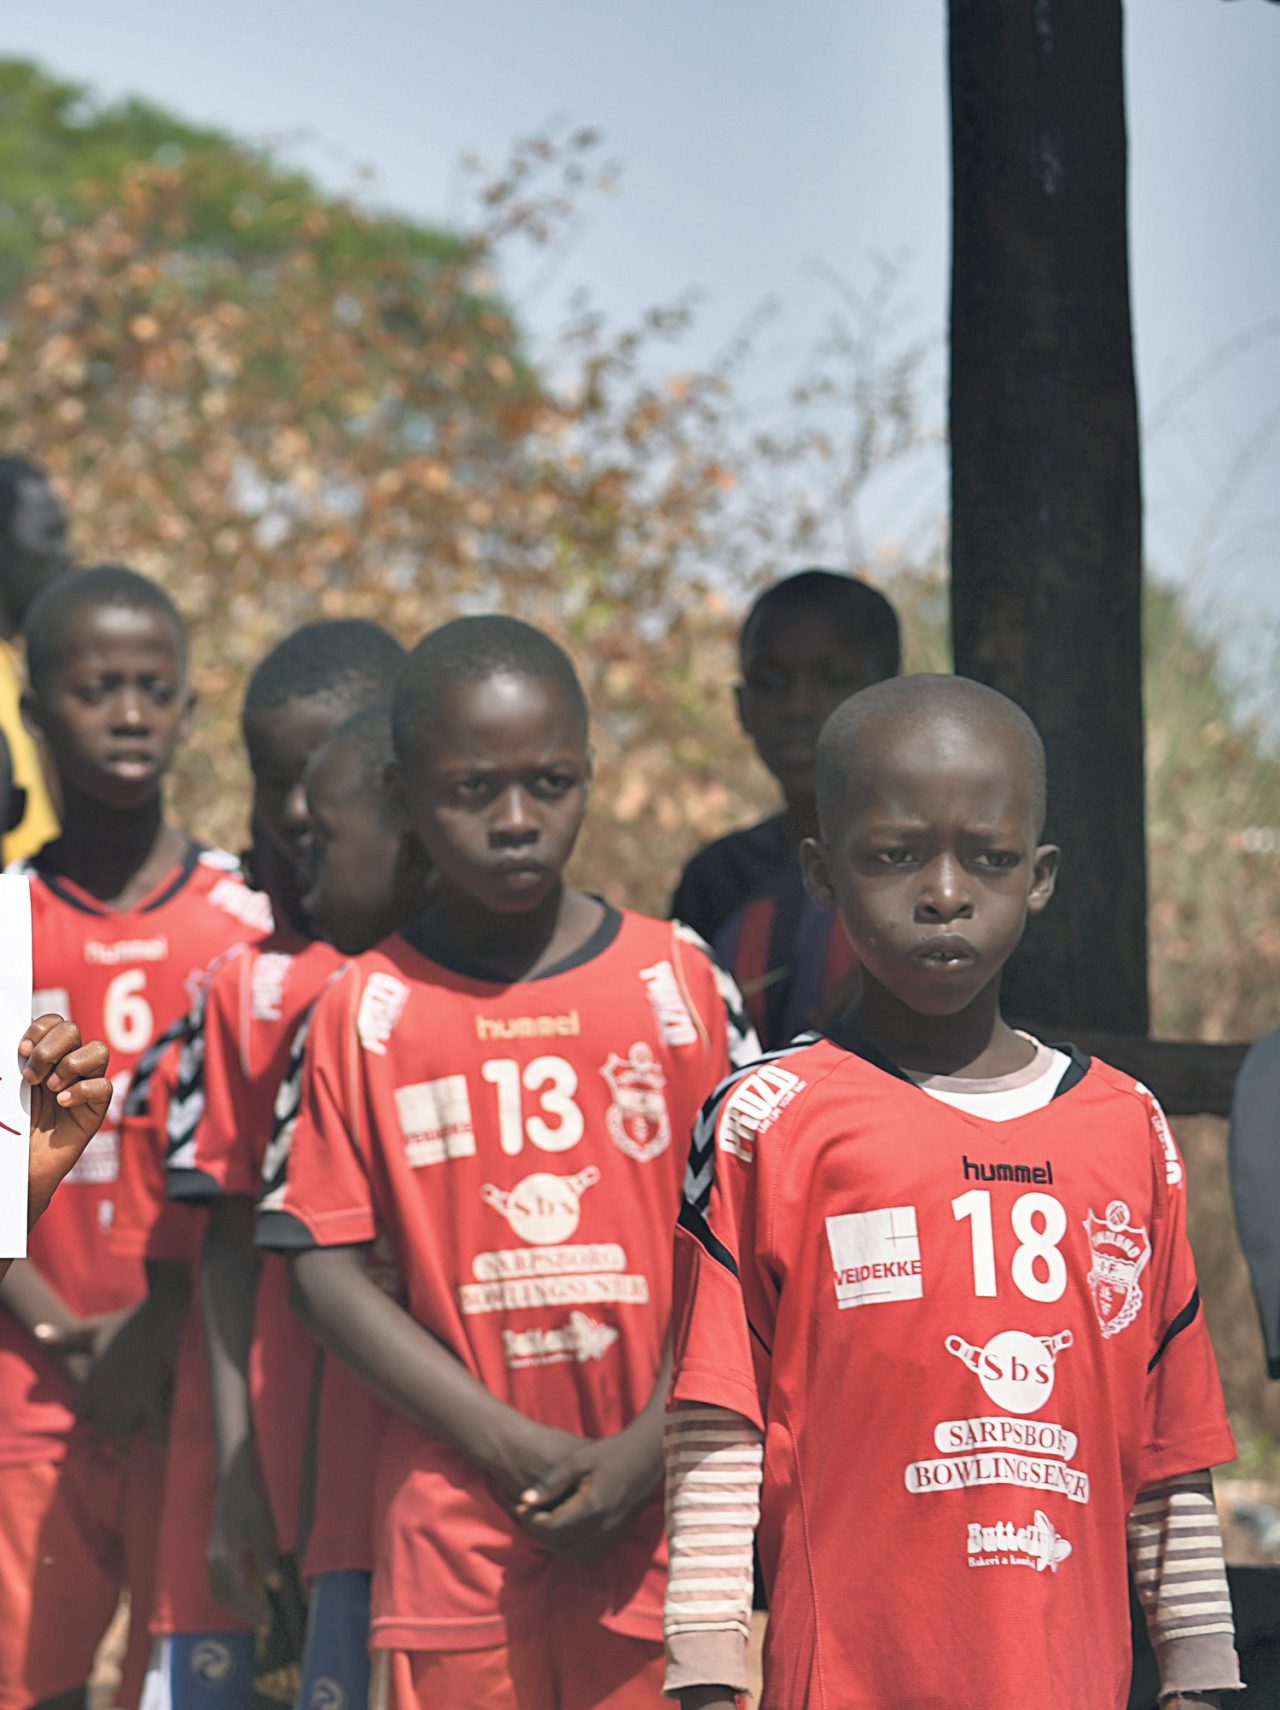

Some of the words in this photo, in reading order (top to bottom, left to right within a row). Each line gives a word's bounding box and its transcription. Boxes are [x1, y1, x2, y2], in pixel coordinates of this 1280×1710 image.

[104, 969, 154, 1054] 6
[476, 1010, 580, 1040] hummel
[482, 1055, 584, 1156] 13
[962, 1156, 1054, 1185] hummel
[951, 1190, 1067, 1303] 18
[835, 1259, 922, 1288] VEIDEKKE
[983, 1353, 1049, 1384] Sbs
